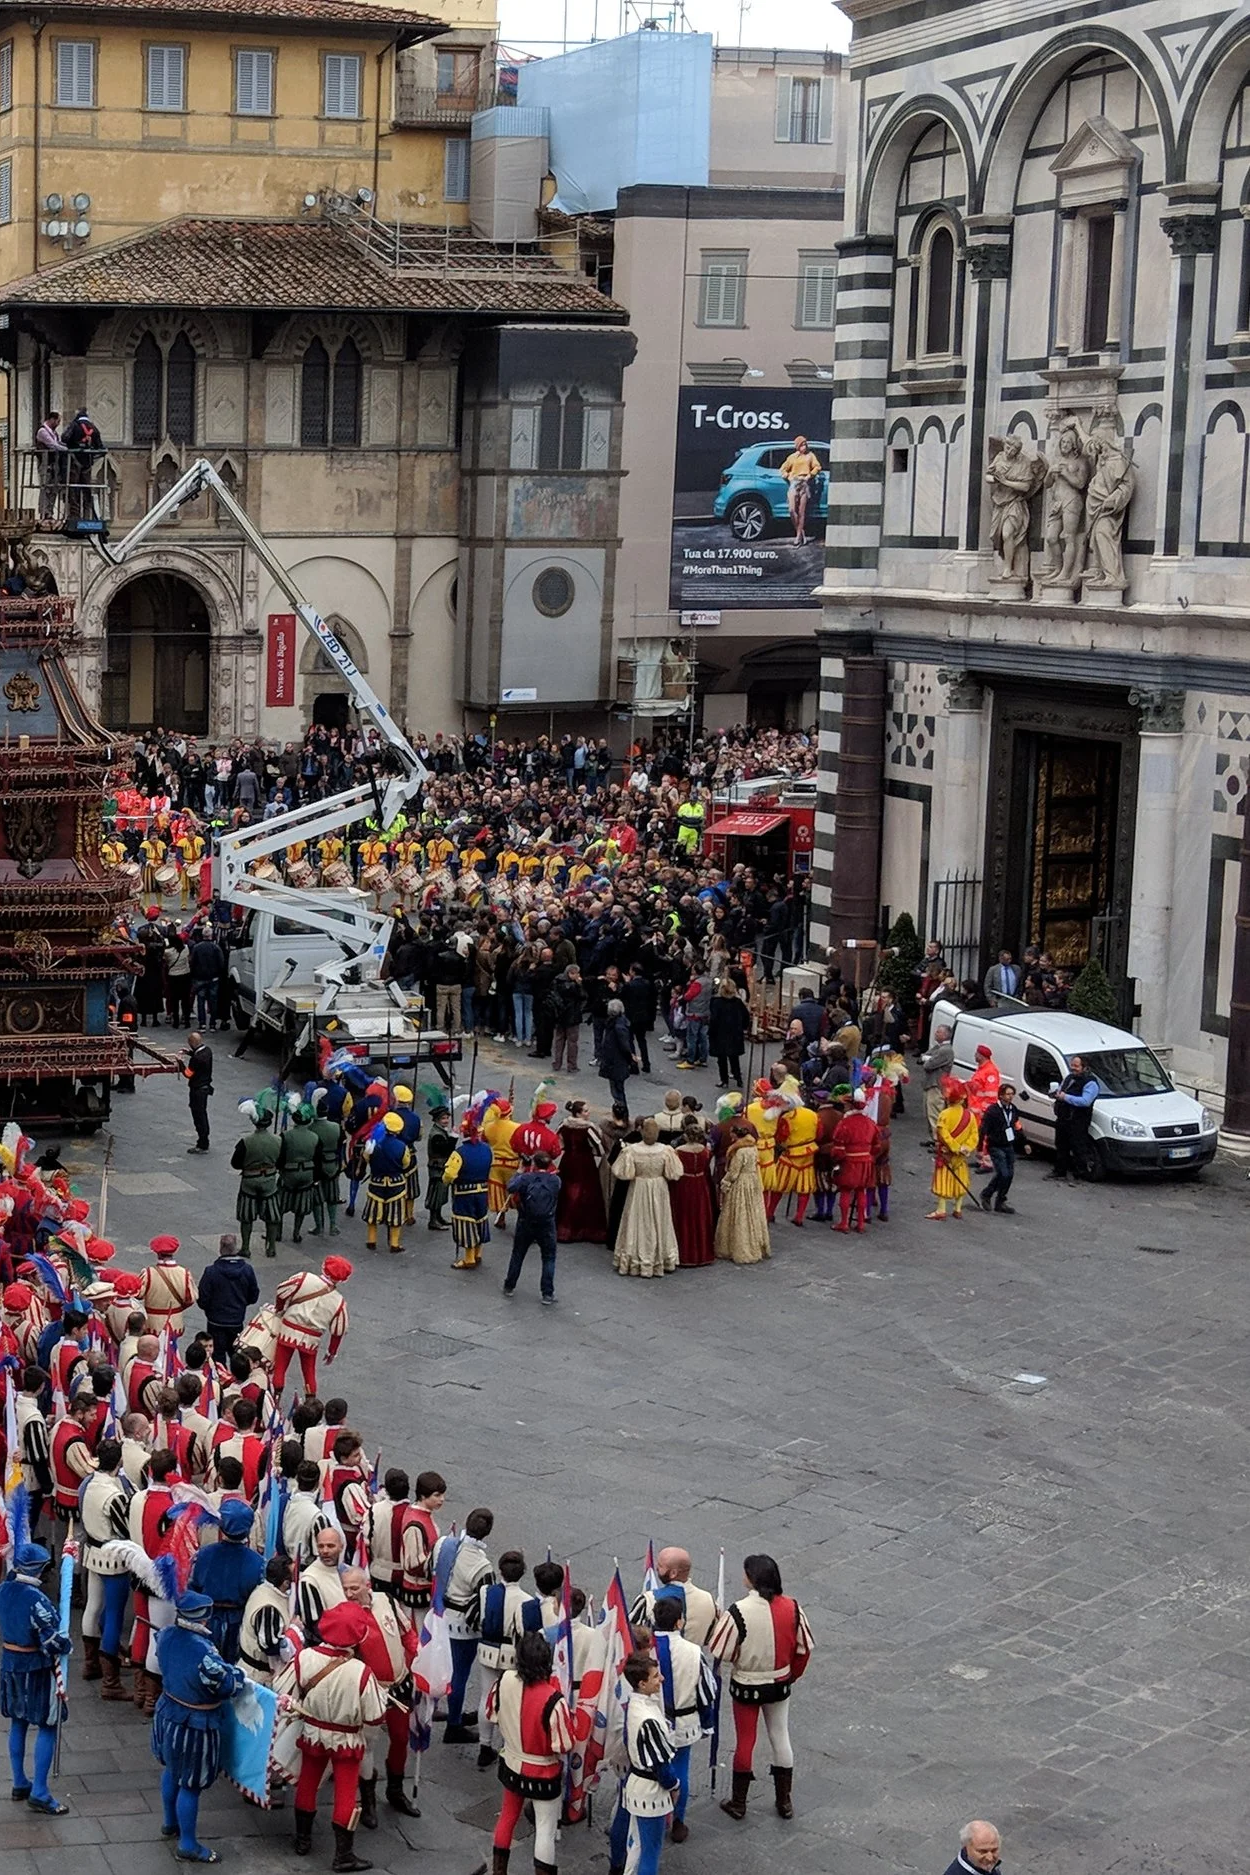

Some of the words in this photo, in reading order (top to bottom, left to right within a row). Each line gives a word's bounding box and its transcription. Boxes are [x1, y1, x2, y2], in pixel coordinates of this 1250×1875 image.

[691, 405, 790, 430] T-Cross.
[683, 549, 701, 559] Tua
[703, 549, 715, 559] da
[718, 549, 752, 559] 17.900
[753, 551, 779, 559] euro.
[682, 565, 763, 576] #MoreThan1Thing
[321, 631, 341, 653] ZED
